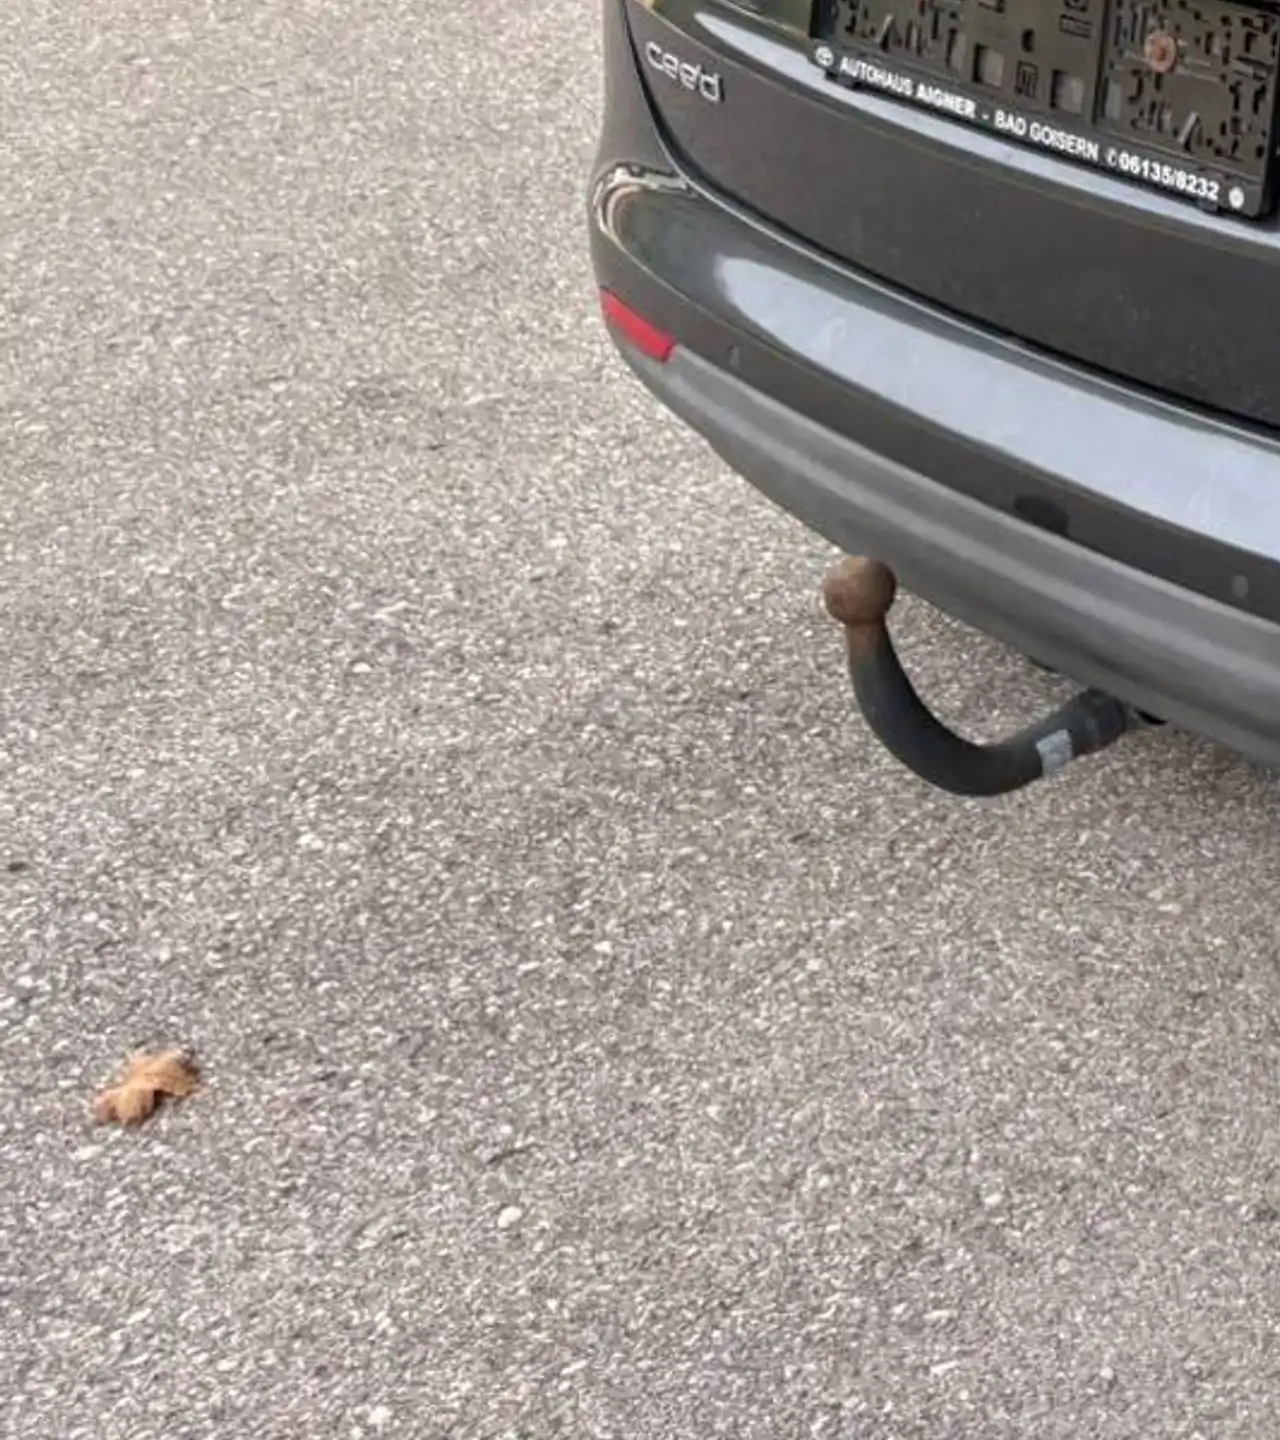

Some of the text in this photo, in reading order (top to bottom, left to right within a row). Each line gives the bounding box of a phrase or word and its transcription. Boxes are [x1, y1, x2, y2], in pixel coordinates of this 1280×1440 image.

[839, 56, 913, 97] AUTOHAUS
[916, 82, 977, 119] AIGNER
[995, 109, 1028, 136] BAD
[1029, 121, 1100, 162] GOISERN
[1118, 150, 1220, 201] 06135/8232
